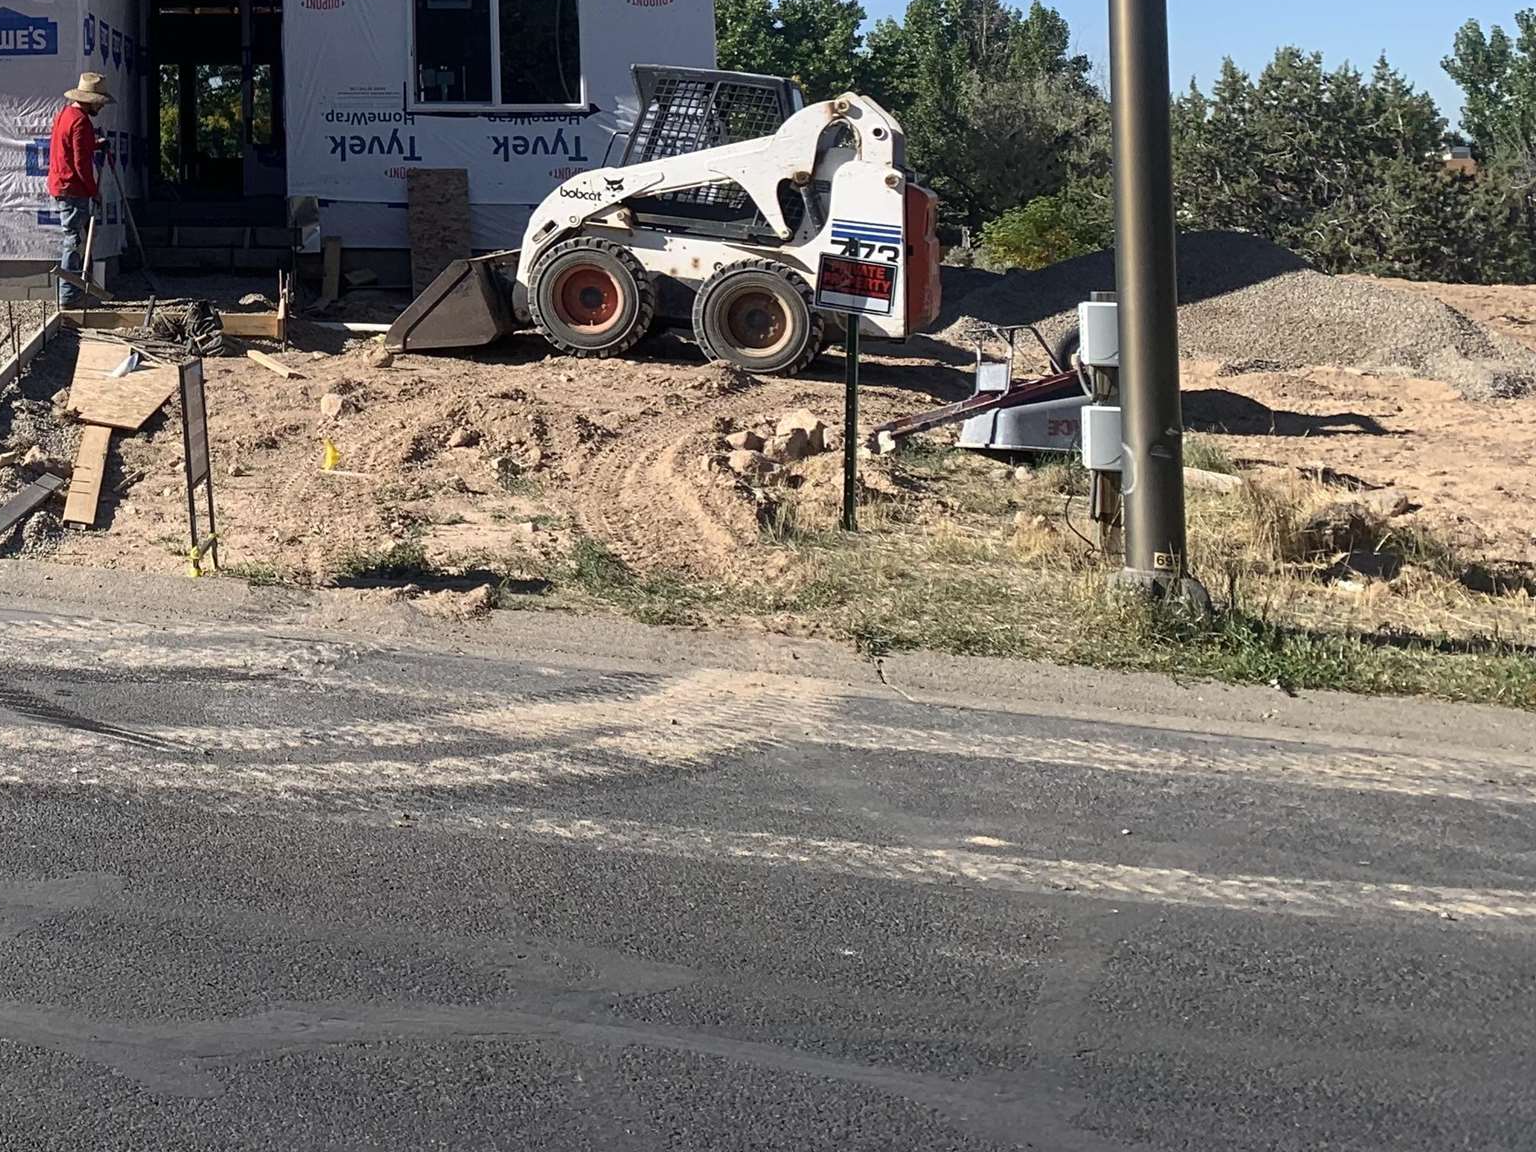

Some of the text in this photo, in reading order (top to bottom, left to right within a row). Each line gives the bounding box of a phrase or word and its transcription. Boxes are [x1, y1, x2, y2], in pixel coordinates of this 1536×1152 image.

[329, 128, 422, 162] Tyvek
[492, 128, 589, 162] Tyvek
[559, 186, 602, 201] bobcat
